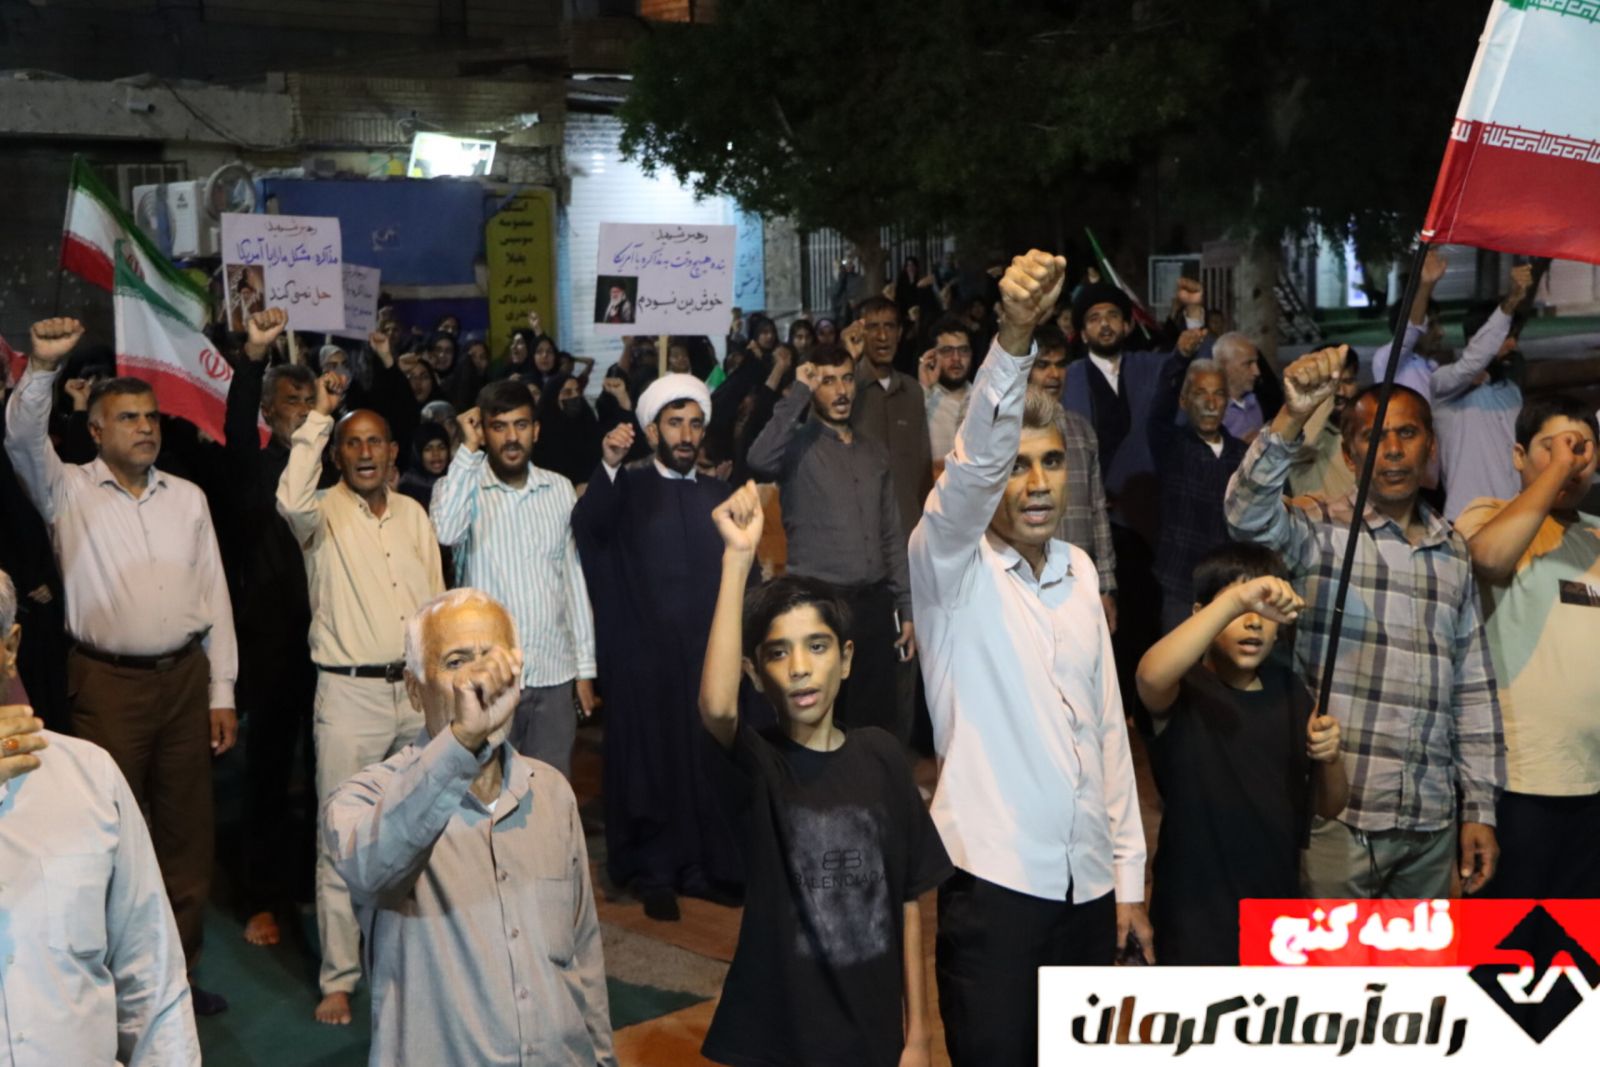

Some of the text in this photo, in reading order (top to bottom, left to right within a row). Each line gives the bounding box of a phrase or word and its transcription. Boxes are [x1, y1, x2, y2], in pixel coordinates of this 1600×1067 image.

[656, 226, 685, 246] شهید
[236, 237, 265, 264] آمریکا
[288, 243, 312, 268] مشکل
[315, 244, 339, 267] مذاکره
[312, 285, 332, 307] حل
